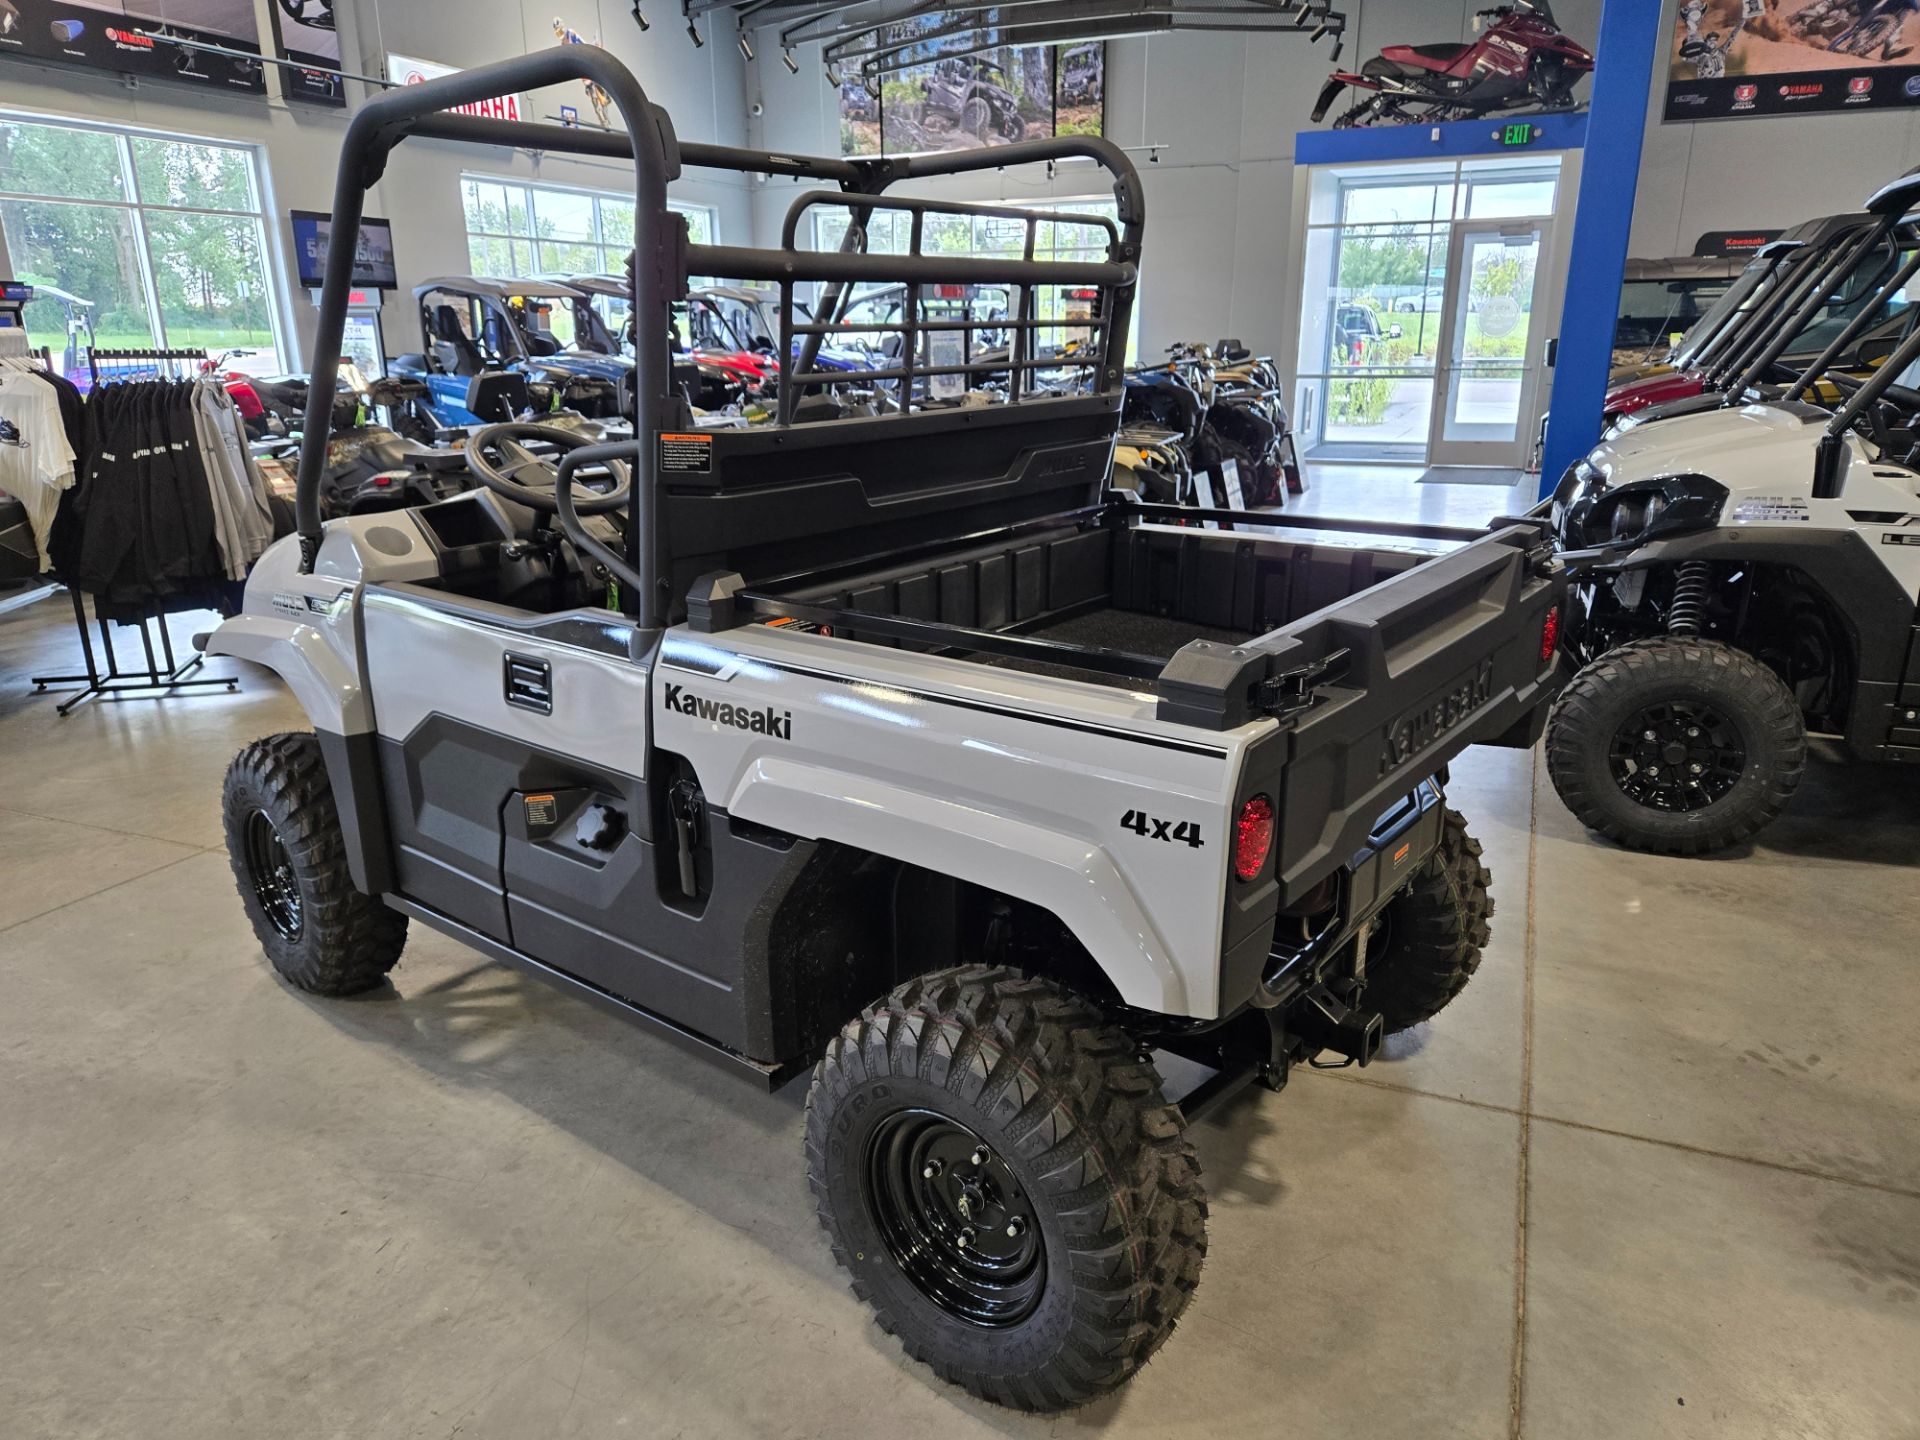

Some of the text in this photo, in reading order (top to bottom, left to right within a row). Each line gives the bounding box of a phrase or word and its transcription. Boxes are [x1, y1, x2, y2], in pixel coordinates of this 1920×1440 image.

[1790, 83, 1823, 95] YAMAHA
[1504, 123, 1531, 145] EXIT
[1725, 237, 1766, 246] Kawasaki
[1735, 496, 1809, 509] MULE
[664, 682, 792, 741] Kawasaki
[1377, 655, 1492, 780] Kawasaki
[1120, 809, 1205, 849] 4x4
